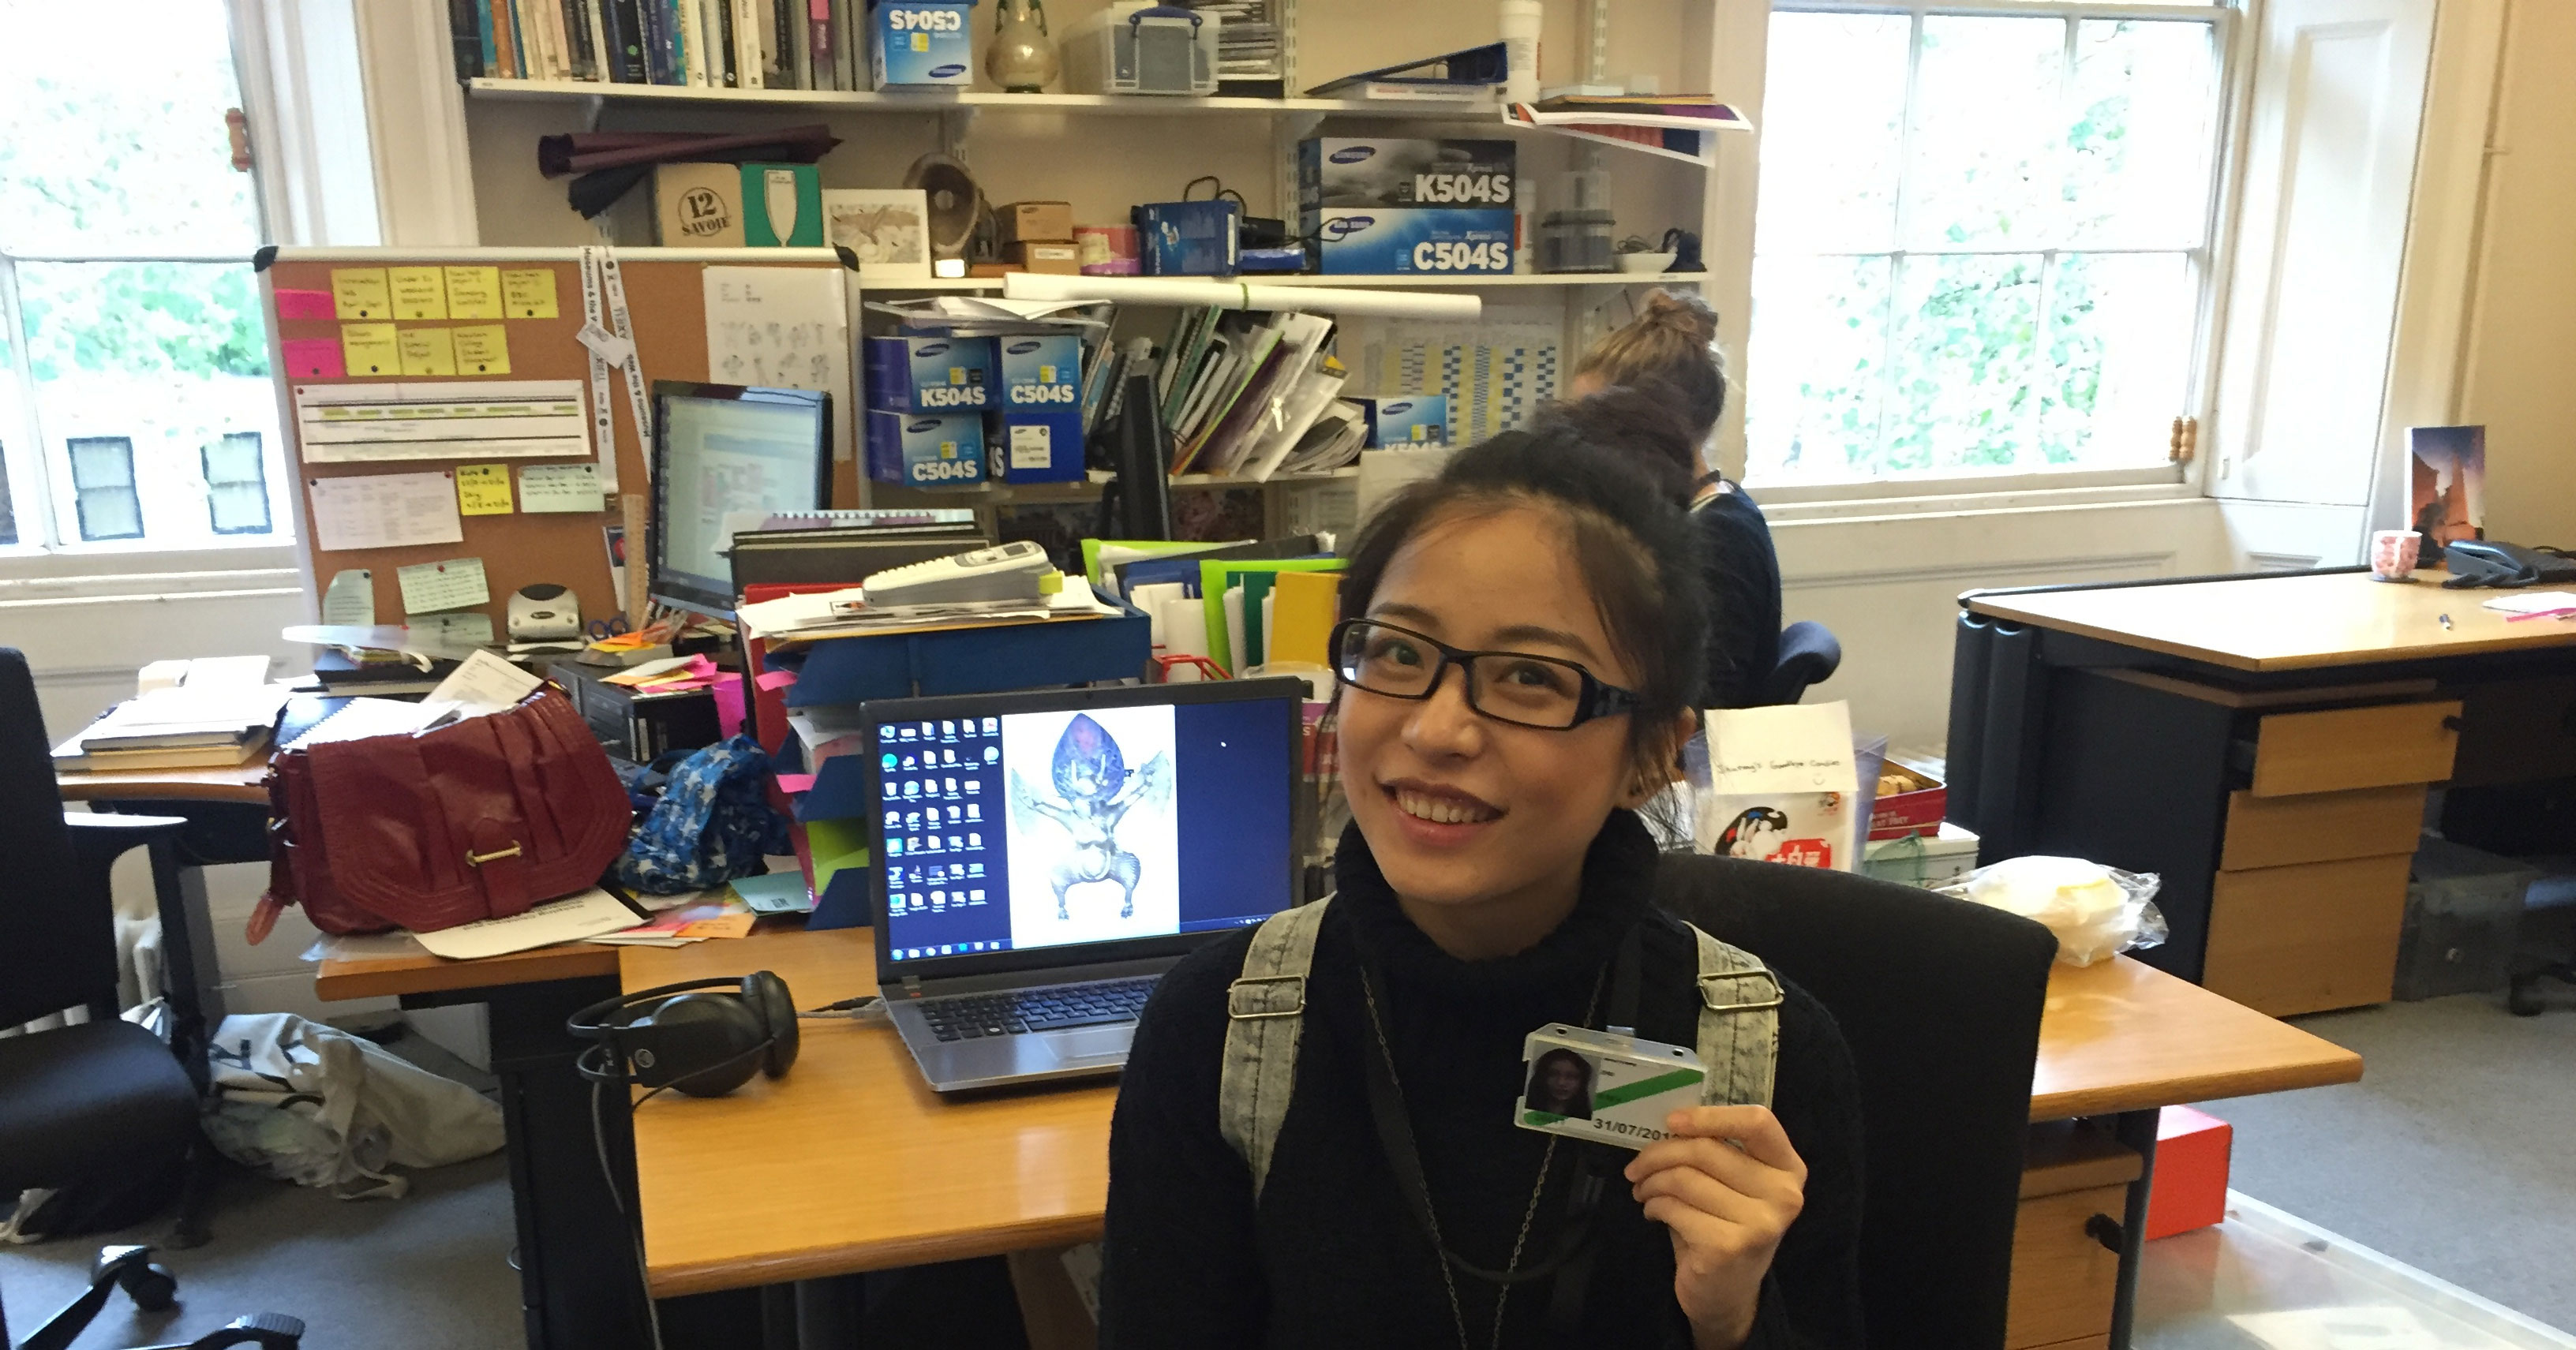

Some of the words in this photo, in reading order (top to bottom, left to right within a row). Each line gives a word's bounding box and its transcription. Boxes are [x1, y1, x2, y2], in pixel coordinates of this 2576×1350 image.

[889, 9, 961, 31] C504S
[1414, 174, 1511, 203] K504S
[687, 193, 717, 219] 12
[682, 216, 732, 237] SAVOIE
[1413, 241, 1509, 271] C504S
[920, 386, 986, 407] K504S
[1010, 384, 1075, 404] C504S
[912, 460, 978, 481] C504S
[1593, 1117, 1679, 1141] 31/07/201
